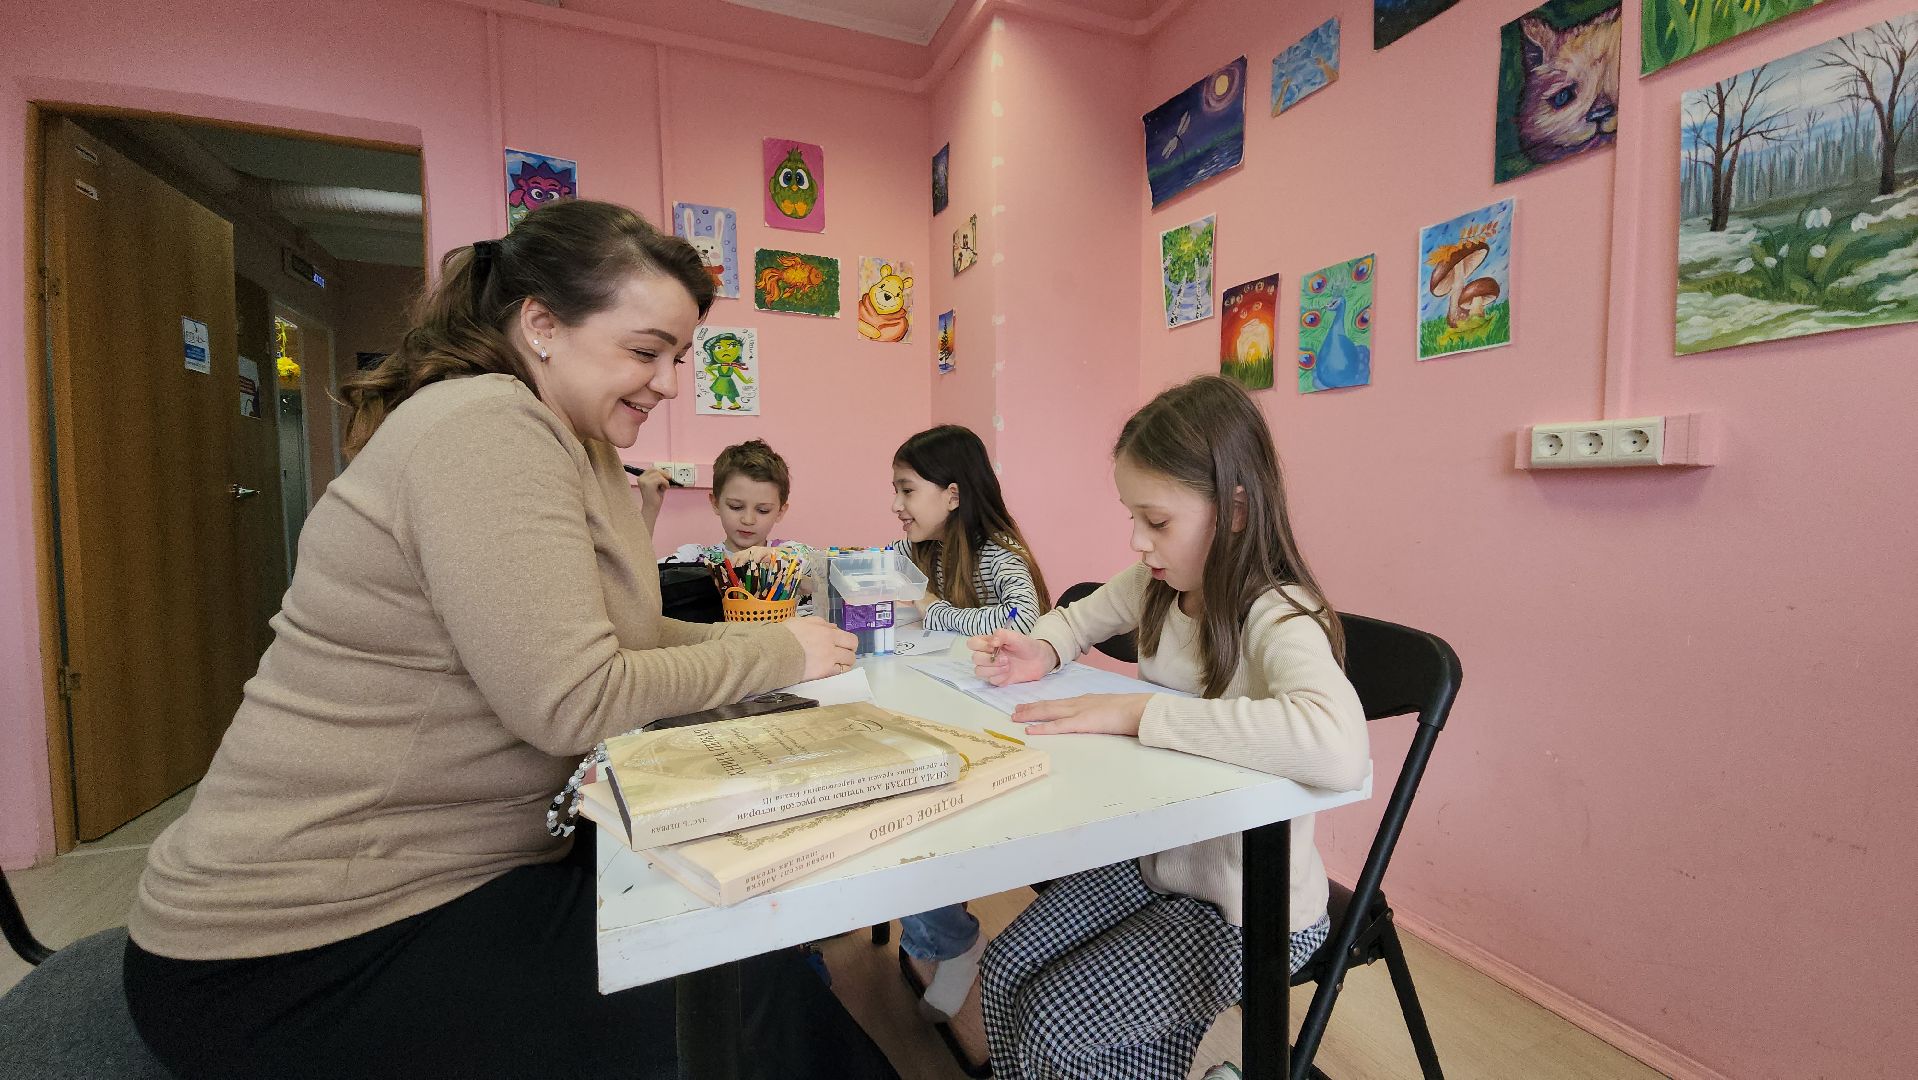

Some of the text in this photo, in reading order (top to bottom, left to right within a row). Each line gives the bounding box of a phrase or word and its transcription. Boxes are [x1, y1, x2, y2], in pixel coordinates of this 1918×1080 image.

[780, 796, 816, 812] русской
[737, 807, 776, 820] истории
[869, 794, 963, 840] РОДНОЕ СЛОВО
